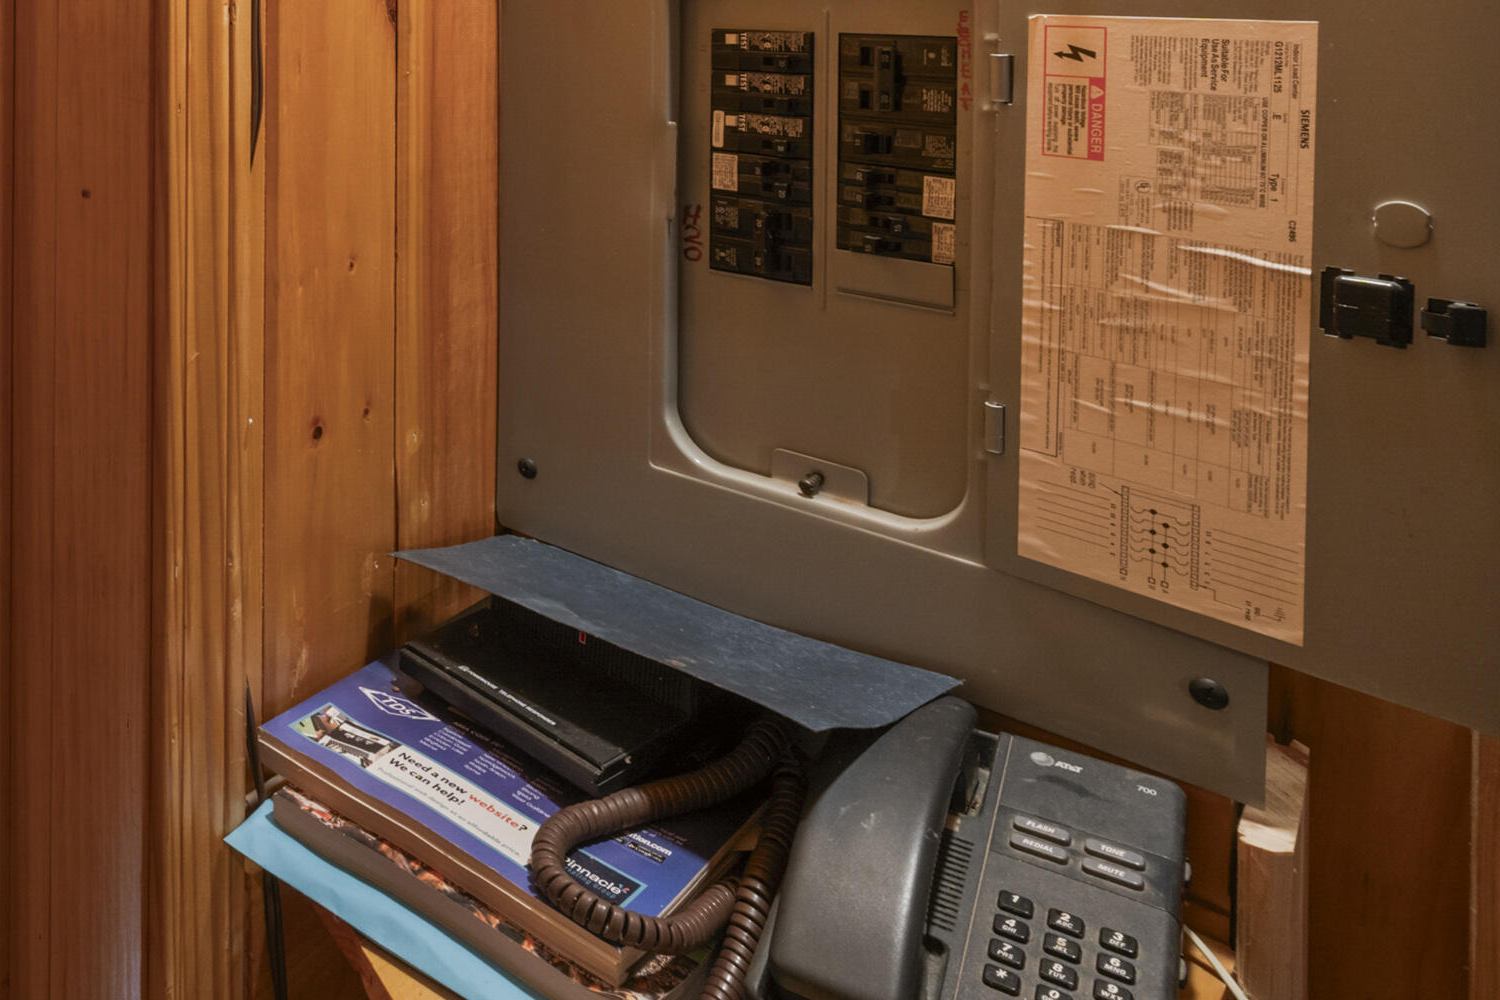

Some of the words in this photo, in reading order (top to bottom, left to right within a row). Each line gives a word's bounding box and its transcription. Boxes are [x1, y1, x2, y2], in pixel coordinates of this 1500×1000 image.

[740, 32, 748, 50] TEST
[1211, 39, 1219, 53] Use
[1200, 38, 1209, 78] Equipment
[1211, 54, 1218, 63] As
[1221, 39, 1229, 69] Suitable
[740, 73, 748, 91] TEST
[1210, 64, 1218, 91] Service
[738, 114, 746, 132] TEST
[1091, 103, 1103, 153] DANGER
[1300, 110, 1310, 149] SIEMENS
[1261, 133, 1267, 141] OR
[1268, 174, 1279, 192] Type
[1288, 220, 1296, 242] C2495
[380, 697, 417, 715] TDS
[1055, 761, 1083, 773] AT&T
[389, 759, 408, 772] We
[409, 771, 430, 784] can
[432, 783, 466, 806] help!
[398, 752, 433, 772] Need
[441, 778, 467, 795] new
[469, 794, 528, 831] website?
[1136, 784, 1157, 796] 700
[1026, 820, 1055, 834] FLASH
[1022, 838, 1053, 853] REDIAL
[1100, 844, 1126, 857] TONE
[1098, 863, 1124, 877] MUTE
[1011, 895, 1020, 903] 1
[1060, 912, 1071, 921] 2
[1002, 925, 1017, 933] GHI
[1056, 920, 1073, 929] ABC
[1056, 937, 1067, 947] 5
[1113, 932, 1124, 941] 3
[1001, 942, 1013, 951] 7
[1053, 944, 1068, 953] JKL
[1109, 939, 1126, 948] DEF
[996, 949, 1013, 960] PRS
[1052, 963, 1064, 971] 8
[1110, 957, 1121, 966] 6
[1048, 970, 1066, 980] TUV
[1104, 964, 1126, 975] MNO
[1048, 989, 1060, 999] 0
[1107, 983, 1119, 993] 9
[1100, 990, 1123, 1000] WXY
